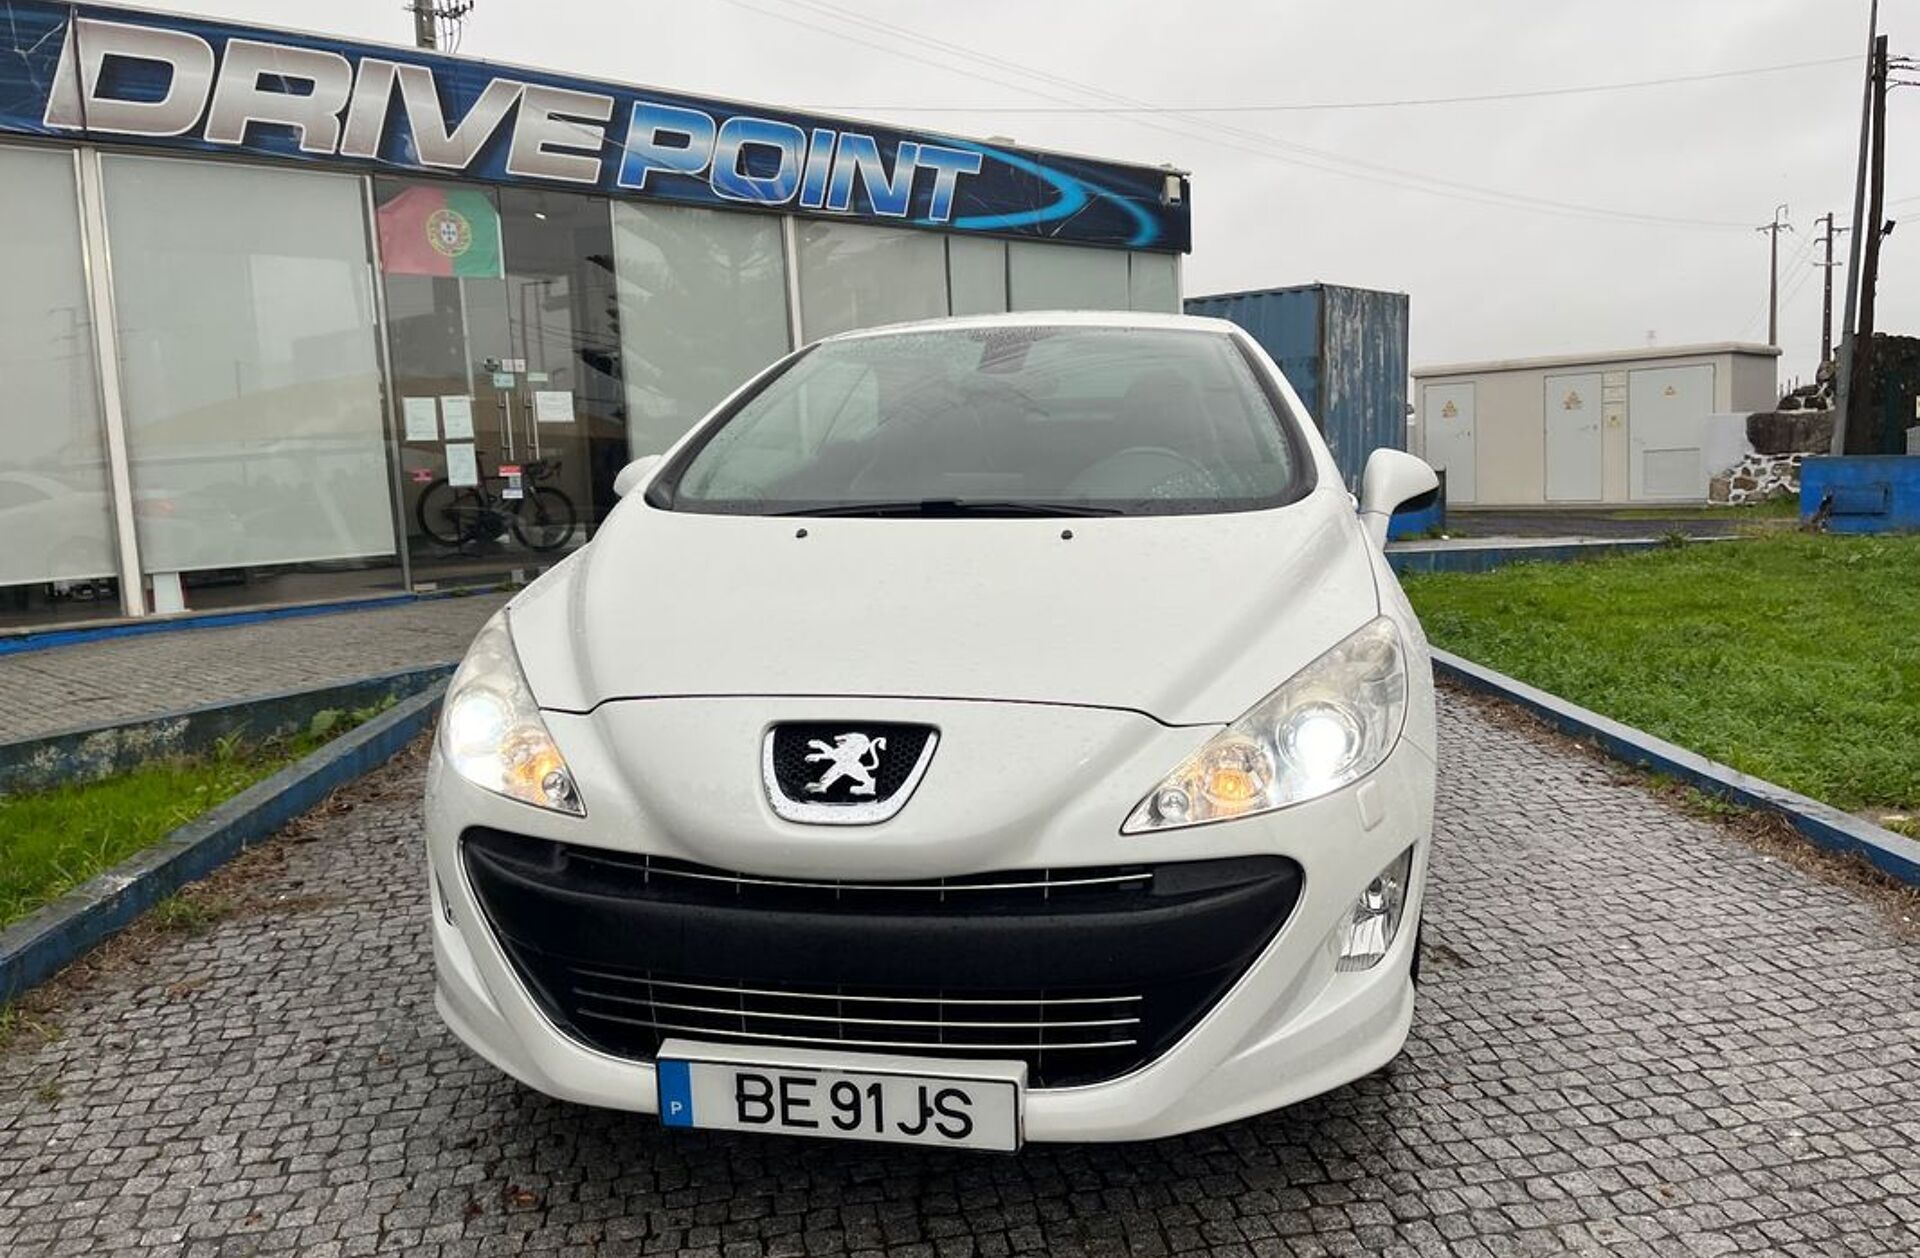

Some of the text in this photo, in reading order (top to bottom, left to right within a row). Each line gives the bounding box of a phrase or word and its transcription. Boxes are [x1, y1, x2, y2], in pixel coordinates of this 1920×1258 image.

[44, 18, 982, 222] DRIVE POINT
[670, 1101, 682, 1115] P
[735, 1072, 973, 1140] BE 91 JS
